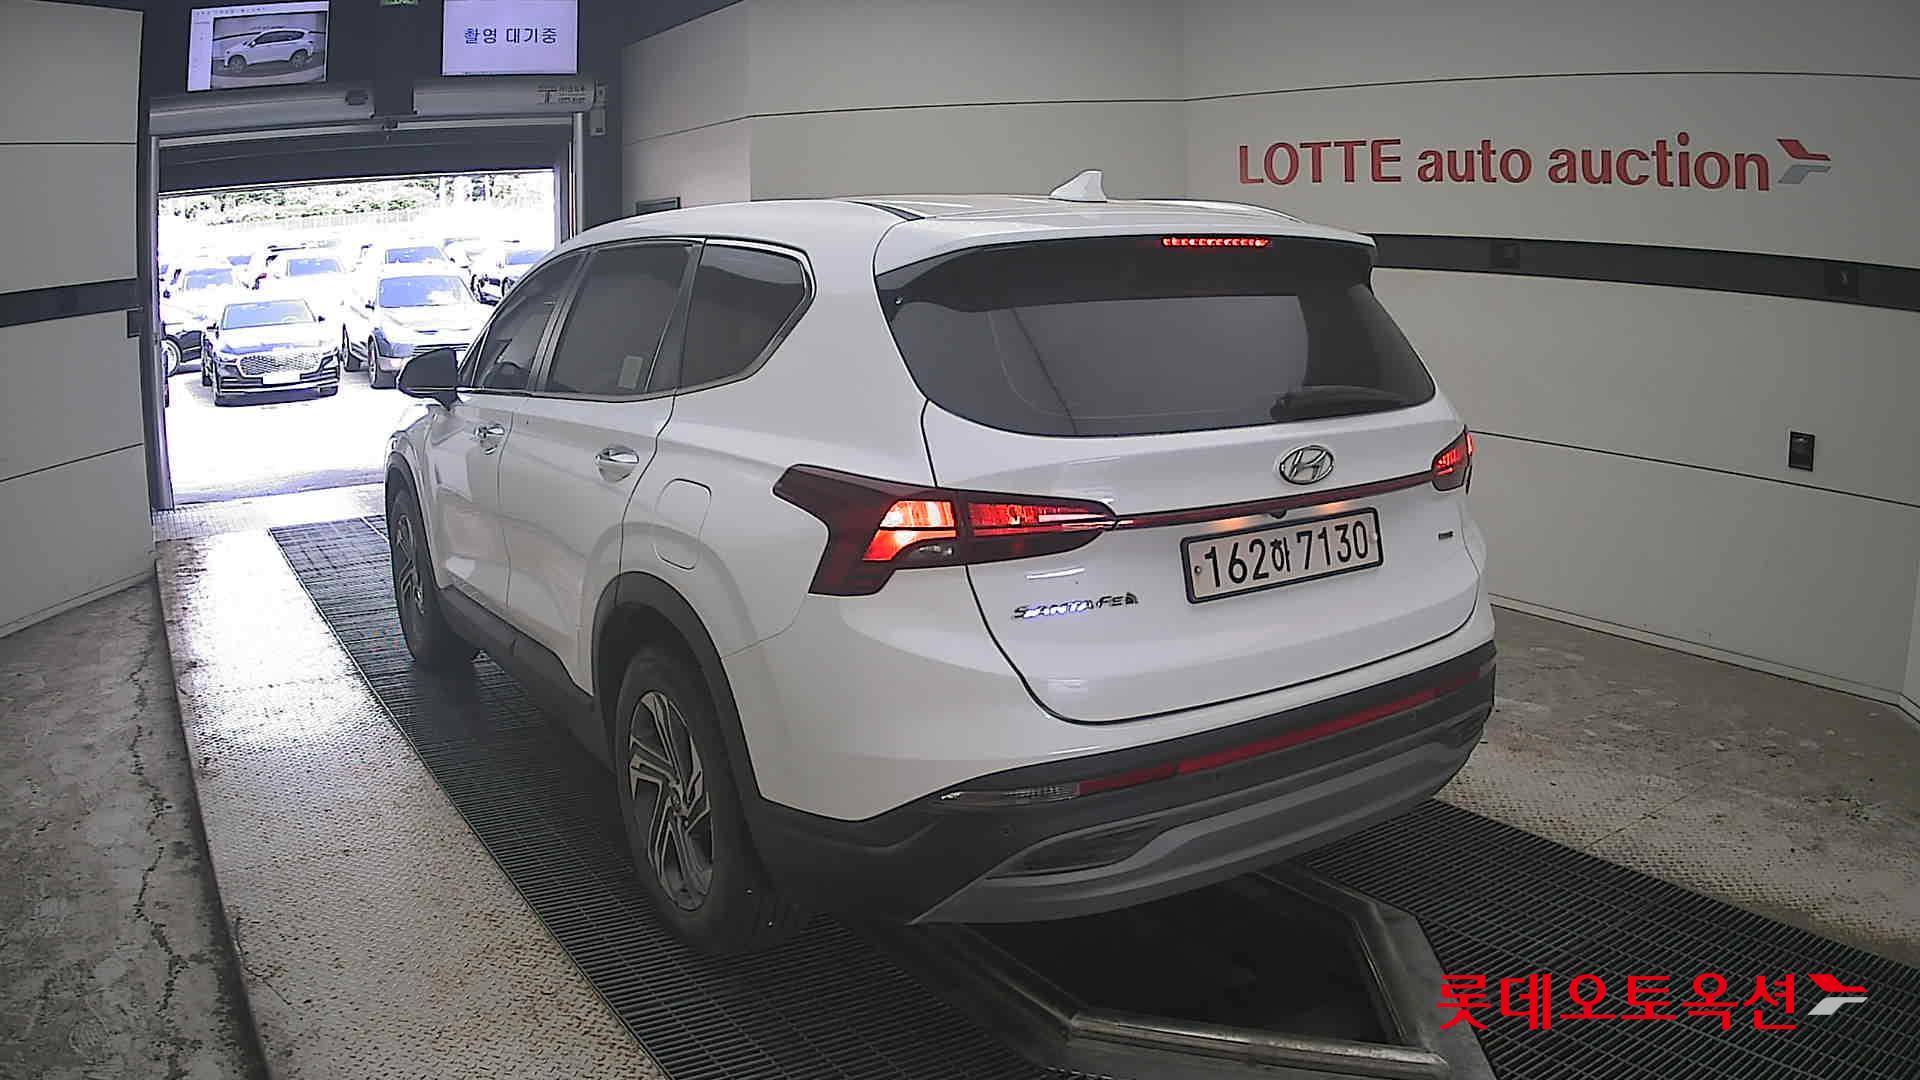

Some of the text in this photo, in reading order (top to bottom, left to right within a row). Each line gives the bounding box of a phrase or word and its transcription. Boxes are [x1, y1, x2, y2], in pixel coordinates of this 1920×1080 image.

[464, 28, 558, 45] 촬영 대기중
[1239, 132, 1770, 190] LOTTE auto auction
